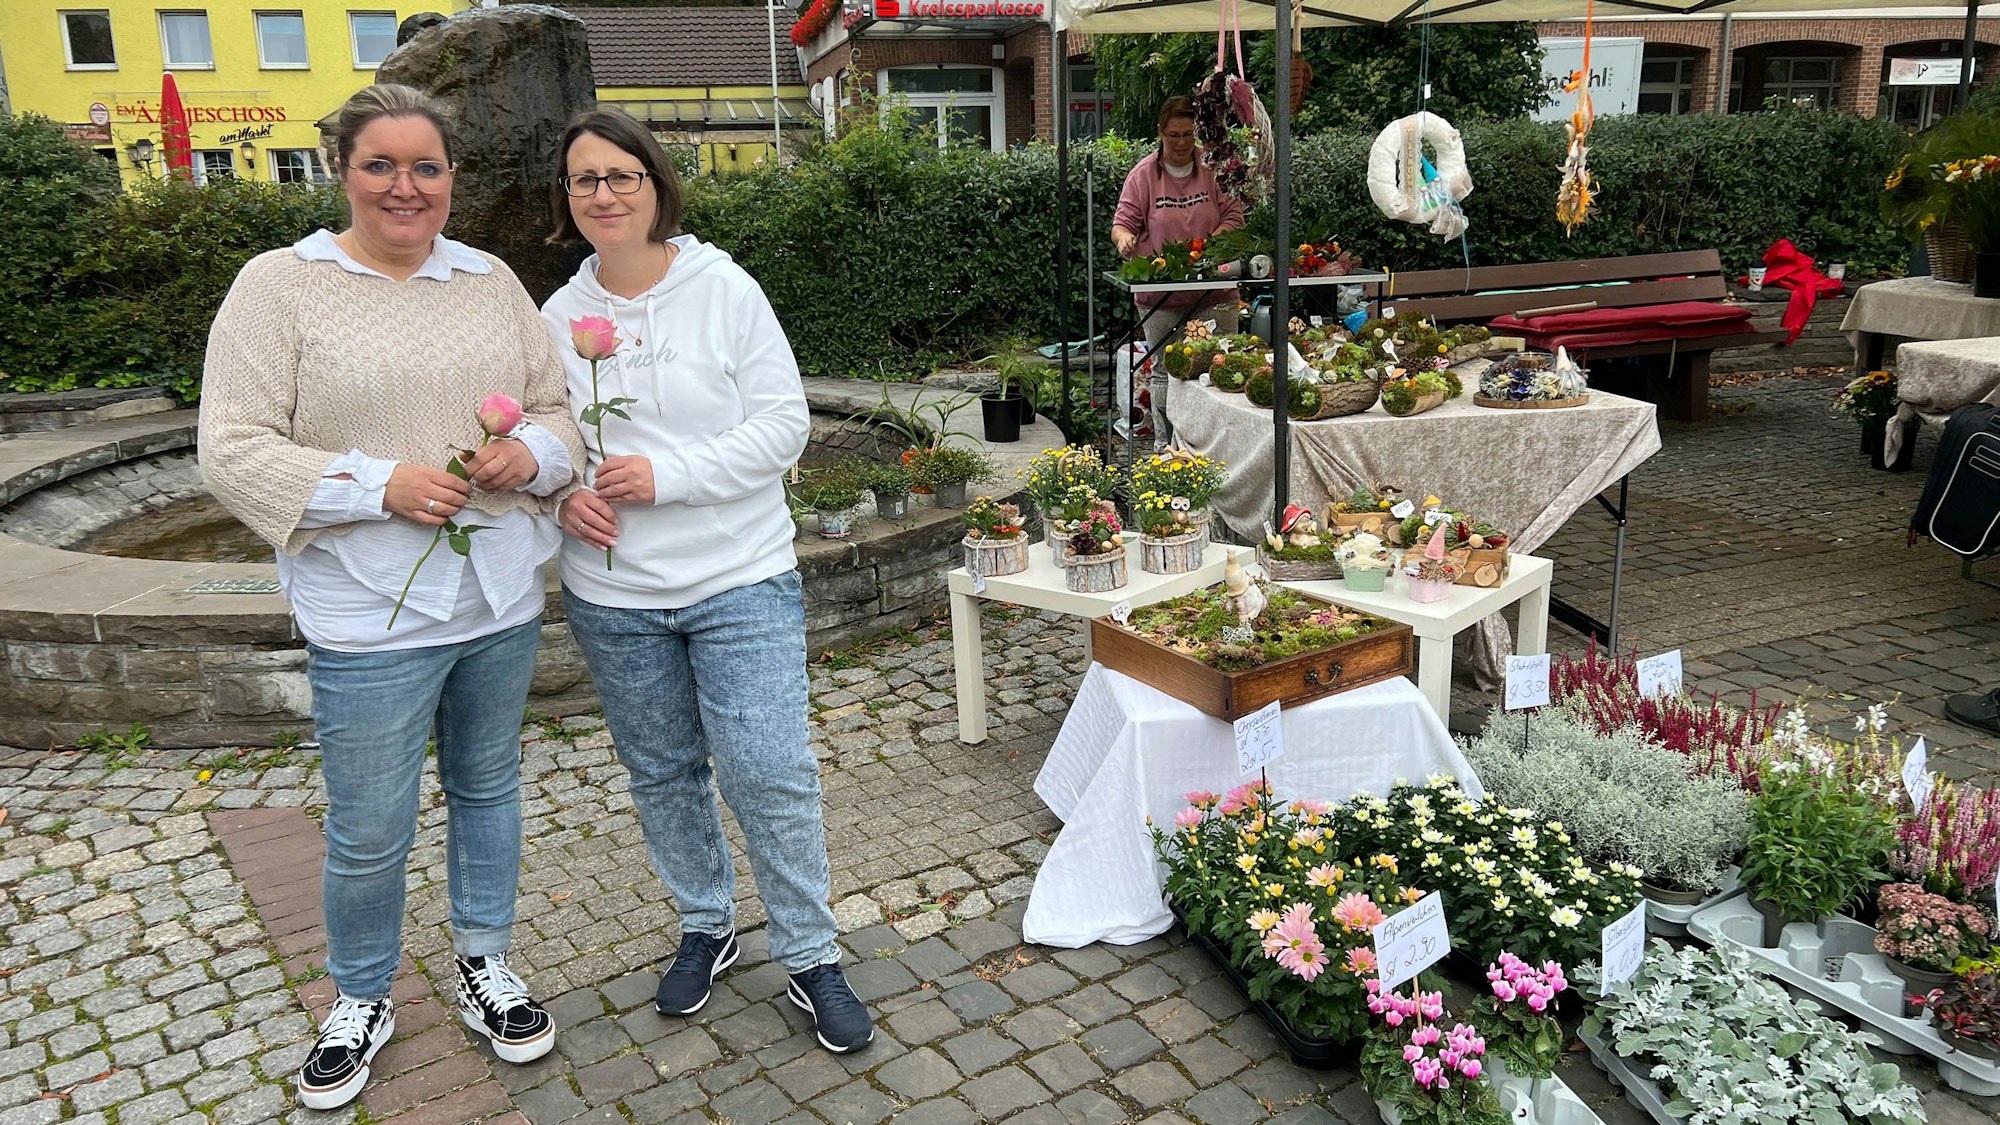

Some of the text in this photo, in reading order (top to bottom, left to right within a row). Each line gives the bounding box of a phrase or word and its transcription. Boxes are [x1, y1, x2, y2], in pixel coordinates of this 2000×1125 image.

[909, 0, 1045, 19] Kreissparkasse
[116, 105, 136, 116] EM
[219, 124, 275, 143] am Markt
[1521, 679, 1547, 698] 3,50
